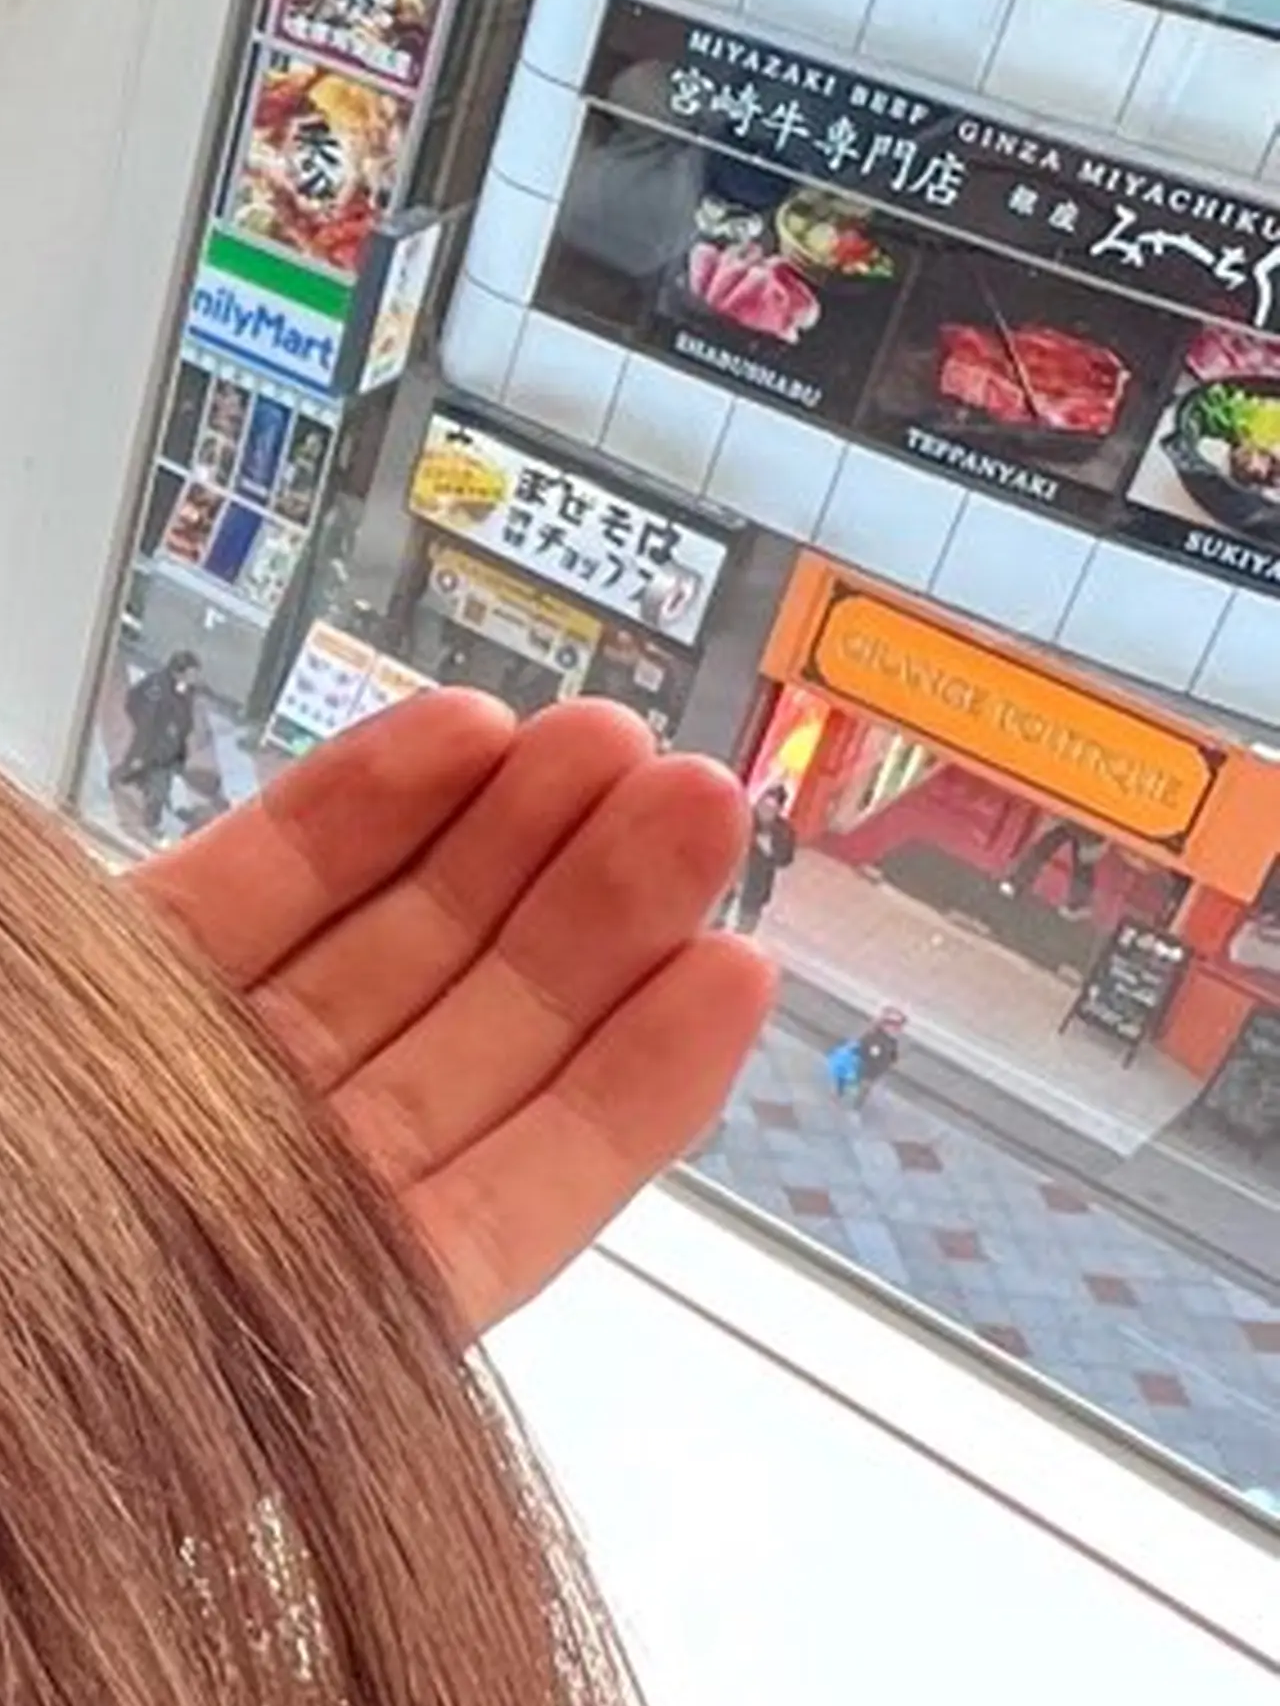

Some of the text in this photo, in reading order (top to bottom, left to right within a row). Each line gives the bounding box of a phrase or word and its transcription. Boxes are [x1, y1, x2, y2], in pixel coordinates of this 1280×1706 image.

[670, 65, 967, 207] 宮崎牛専門店
[689, 29, 1280, 241] MIYAZAKI BEEF GINZA MIYACHIKU
[674, 330, 823, 409] SHABUSHABU
[906, 427, 1061, 503] TEPPANYAKI
